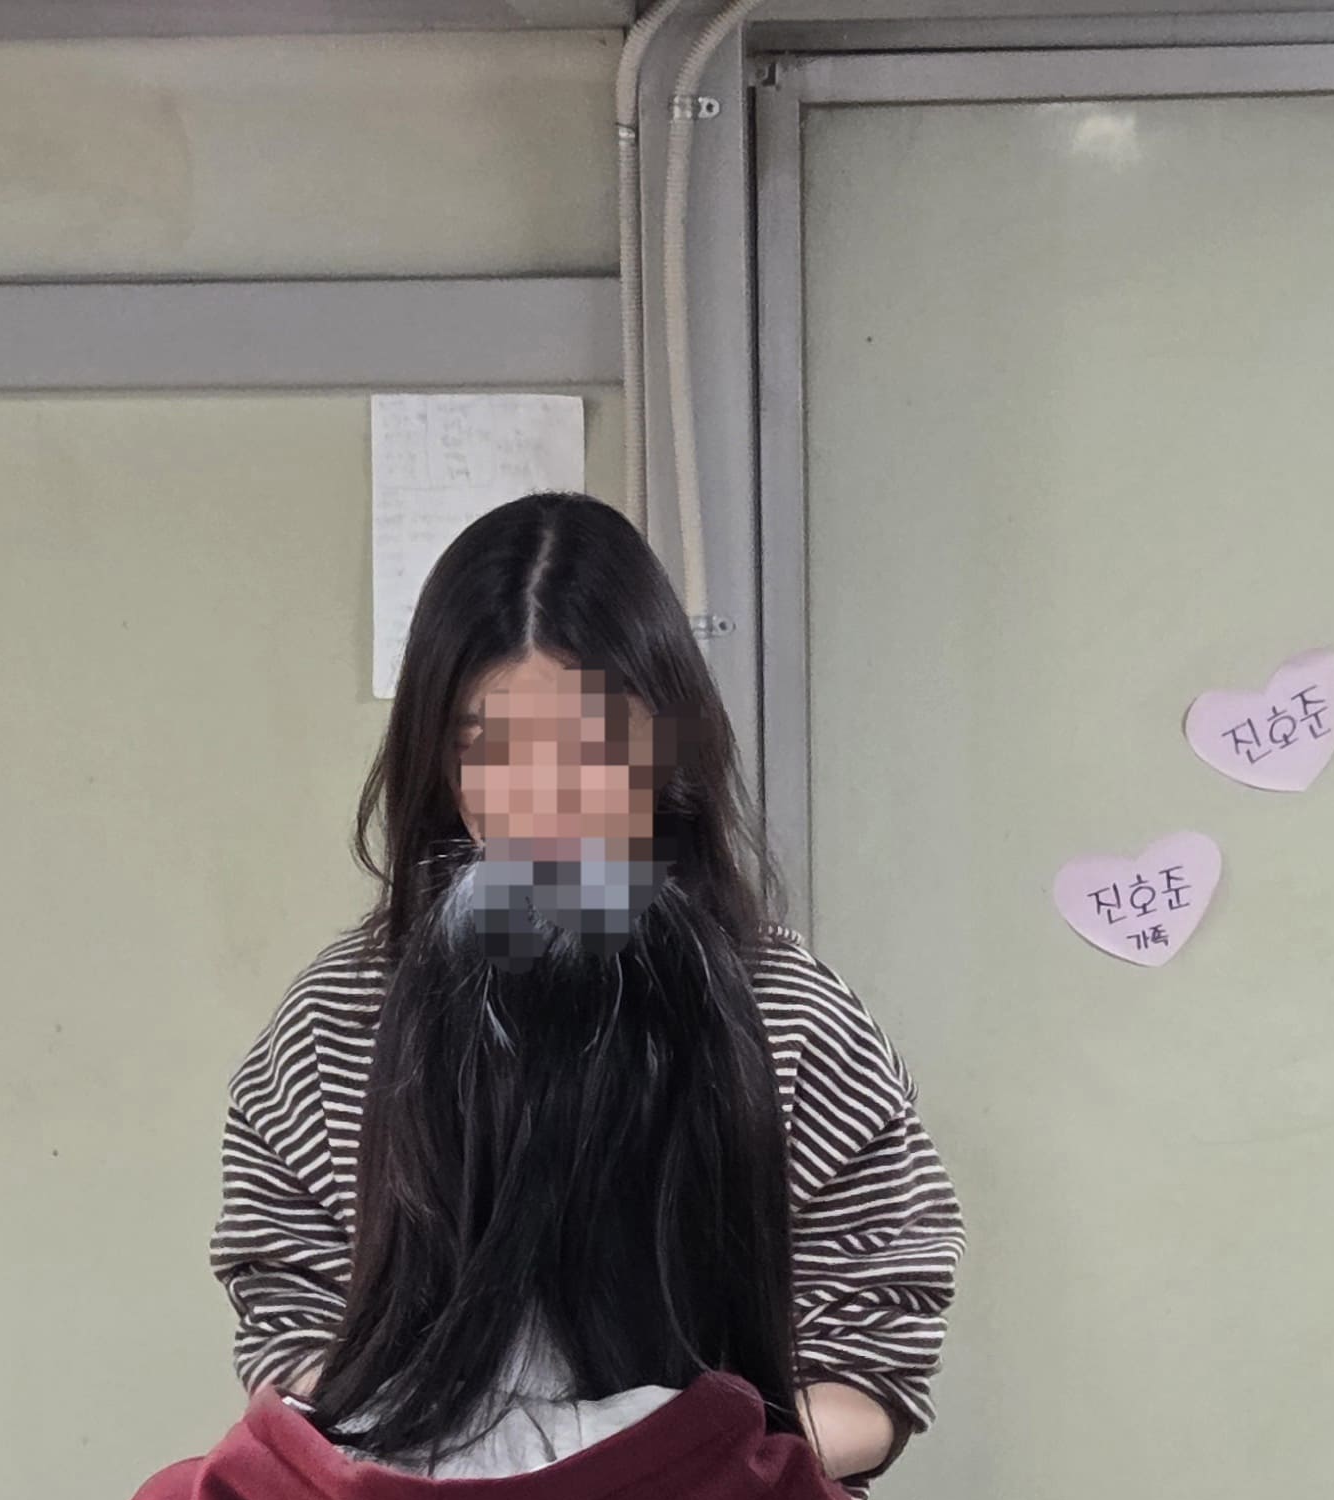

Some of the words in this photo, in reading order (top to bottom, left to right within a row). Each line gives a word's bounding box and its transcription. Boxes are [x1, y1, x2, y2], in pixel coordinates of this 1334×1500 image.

[1221, 684, 1332, 764] 진호준
[1087, 865, 1192, 924] 진호준
[1126, 924, 1169, 950] 가족
